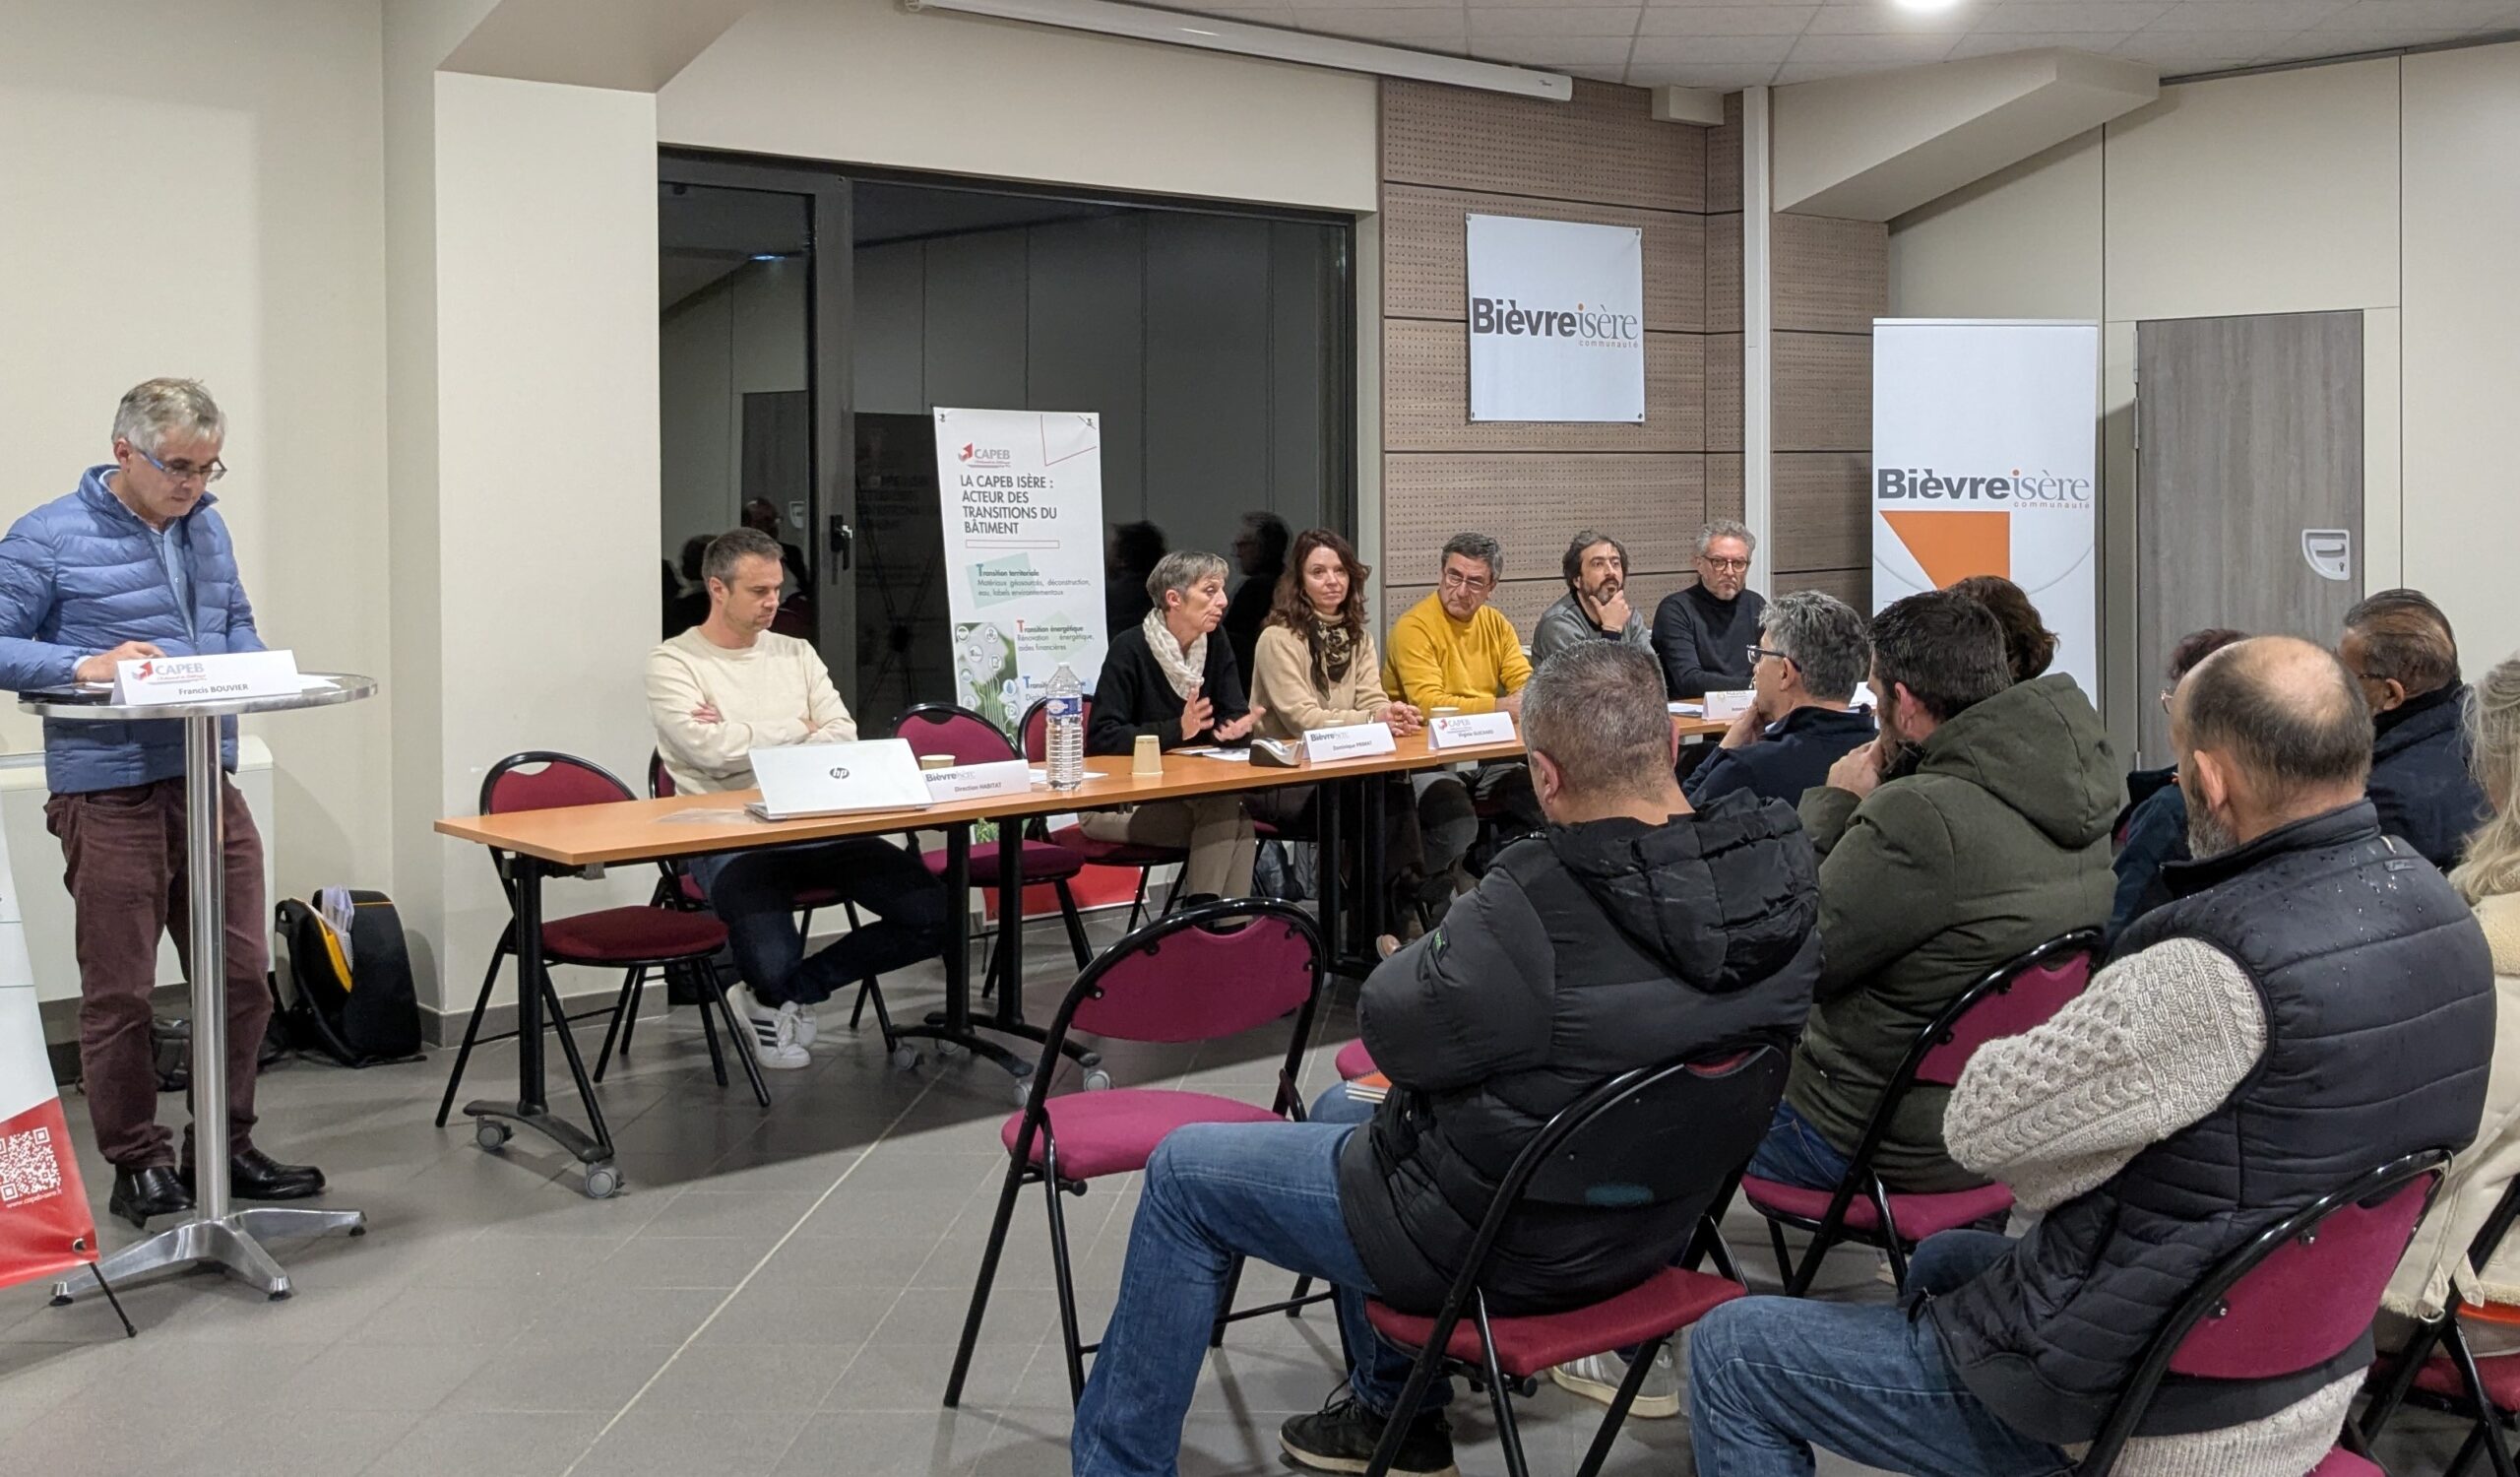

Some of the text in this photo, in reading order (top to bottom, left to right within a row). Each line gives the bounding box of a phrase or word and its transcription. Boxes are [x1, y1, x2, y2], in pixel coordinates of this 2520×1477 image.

[975, 449, 1010, 460] CAPEB
[961, 475, 974, 487] LA
[976, 475, 1014, 488] CAPEB
[1017, 473, 1046, 488] ISÈRE
[962, 490, 1030, 503] ACTEUR DES
[2014, 500, 2090, 509] communauté
[963, 505, 1057, 519] TRANSITIONS DU
[965, 518, 1019, 534] BÂTIMENT
[976, 563, 1008, 577] Transition
[977, 578, 1007, 587] Matériaux
[1047, 577, 1092, 587] déconstruction,
[1017, 619, 1084, 634] Transition énergétique
[1017, 633, 1049, 642] Rénovation
[155, 662, 205, 675] CAPEB
[178, 683, 248, 695] Francis BOUVIER
[830, 767, 850, 779] hp
